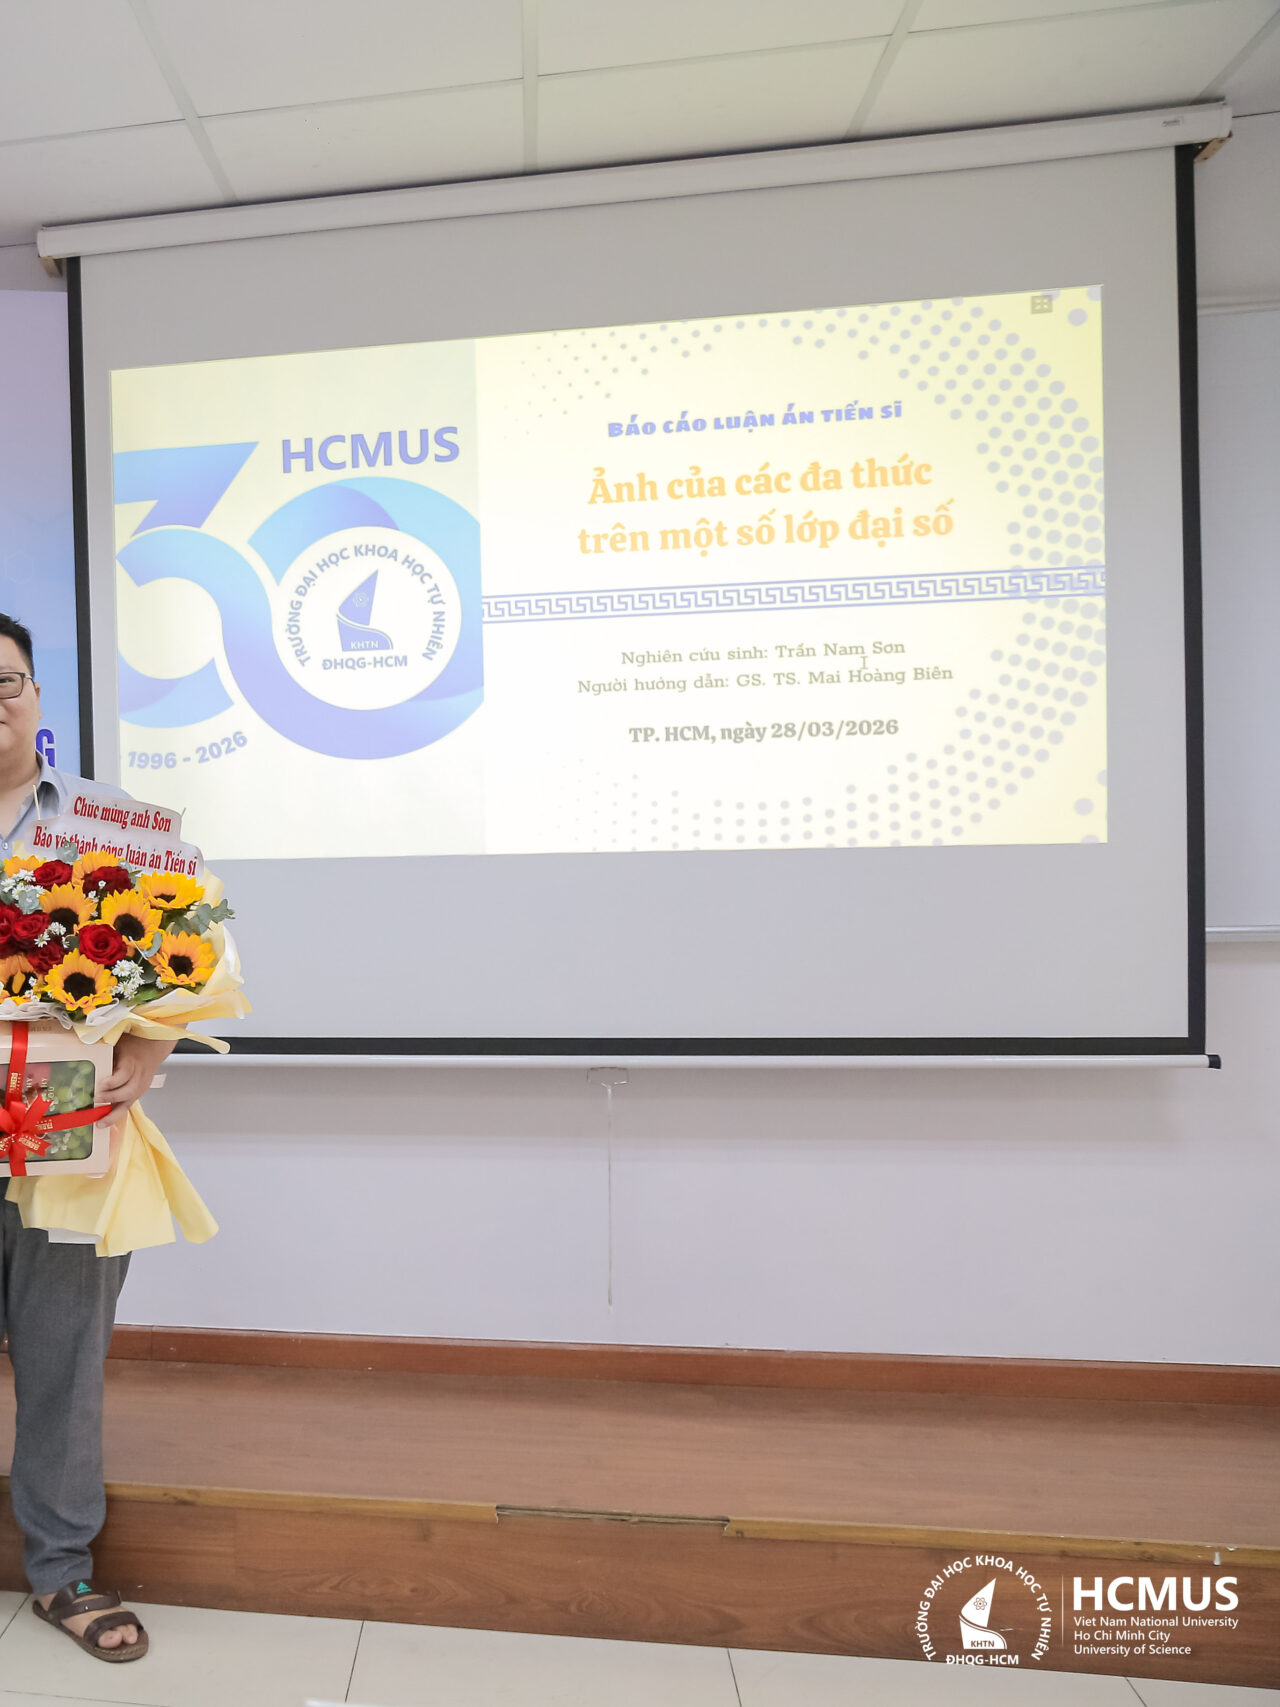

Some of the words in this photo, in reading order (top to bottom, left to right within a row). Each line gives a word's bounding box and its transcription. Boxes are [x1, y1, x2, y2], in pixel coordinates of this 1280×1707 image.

[608, 414, 656, 438] BÁO
[663, 410, 707, 434] CÁO
[714, 410, 775, 433] LUẬN
[782, 402, 814, 426] ÁN
[821, 400, 873, 422] TIẾN
[880, 400, 903, 419] SĨ
[282, 426, 460, 474] HCMUS
[587, 466, 659, 505] Ảnh
[666, 465, 726, 500] của
[735, 461, 792, 496] các
[799, 461, 843, 492] đa
[850, 452, 933, 489] thức
[577, 521, 651, 554] trên
[659, 517, 728, 558] một
[736, 508, 777, 547] số
[784, 509, 839, 549] lớp
[848, 506, 904, 548] đại
[912, 497, 955, 537] số
[316, 548, 350, 572] HỌC
[354, 544, 399, 562] KHOA
[295, 570, 318, 597] ĐẠI
[401, 554, 433, 584] HỌC
[426, 584, 446, 606] TỰ
[285, 600, 311, 667] TRƯỜNG
[350, 640, 379, 650] KHTN
[422, 611, 445, 661] NHIÊN
[322, 655, 408, 670] ĐHQG-HCM
[621, 649, 683, 668] Nghiên
[689, 647, 721, 662] cứu
[727, 646, 768, 660] sinh:
[823, 642, 866, 657] Nam
[872, 641, 906, 655] Sơn
[577, 678, 628, 696] Người
[693, 673, 730, 689] dẫn:
[736, 674, 766, 687] GS.
[773, 672, 801, 686] TS.
[808, 670, 841, 685] Mai
[848, 668, 906, 685] Hoàng
[913, 666, 953, 681] Biên
[629, 727, 661, 743] TP.
[665, 725, 717, 744] HCM,
[721, 721, 767, 744] ngày
[771, 719, 899, 742] 28/03/2026
[128, 750, 177, 769] 1996
[196, 731, 248, 764] 2026
[73, 796, 99, 819] Chúc
[131, 810, 150, 828] anh
[148, 849, 161, 869] án
[164, 850, 185, 873] Tiến
